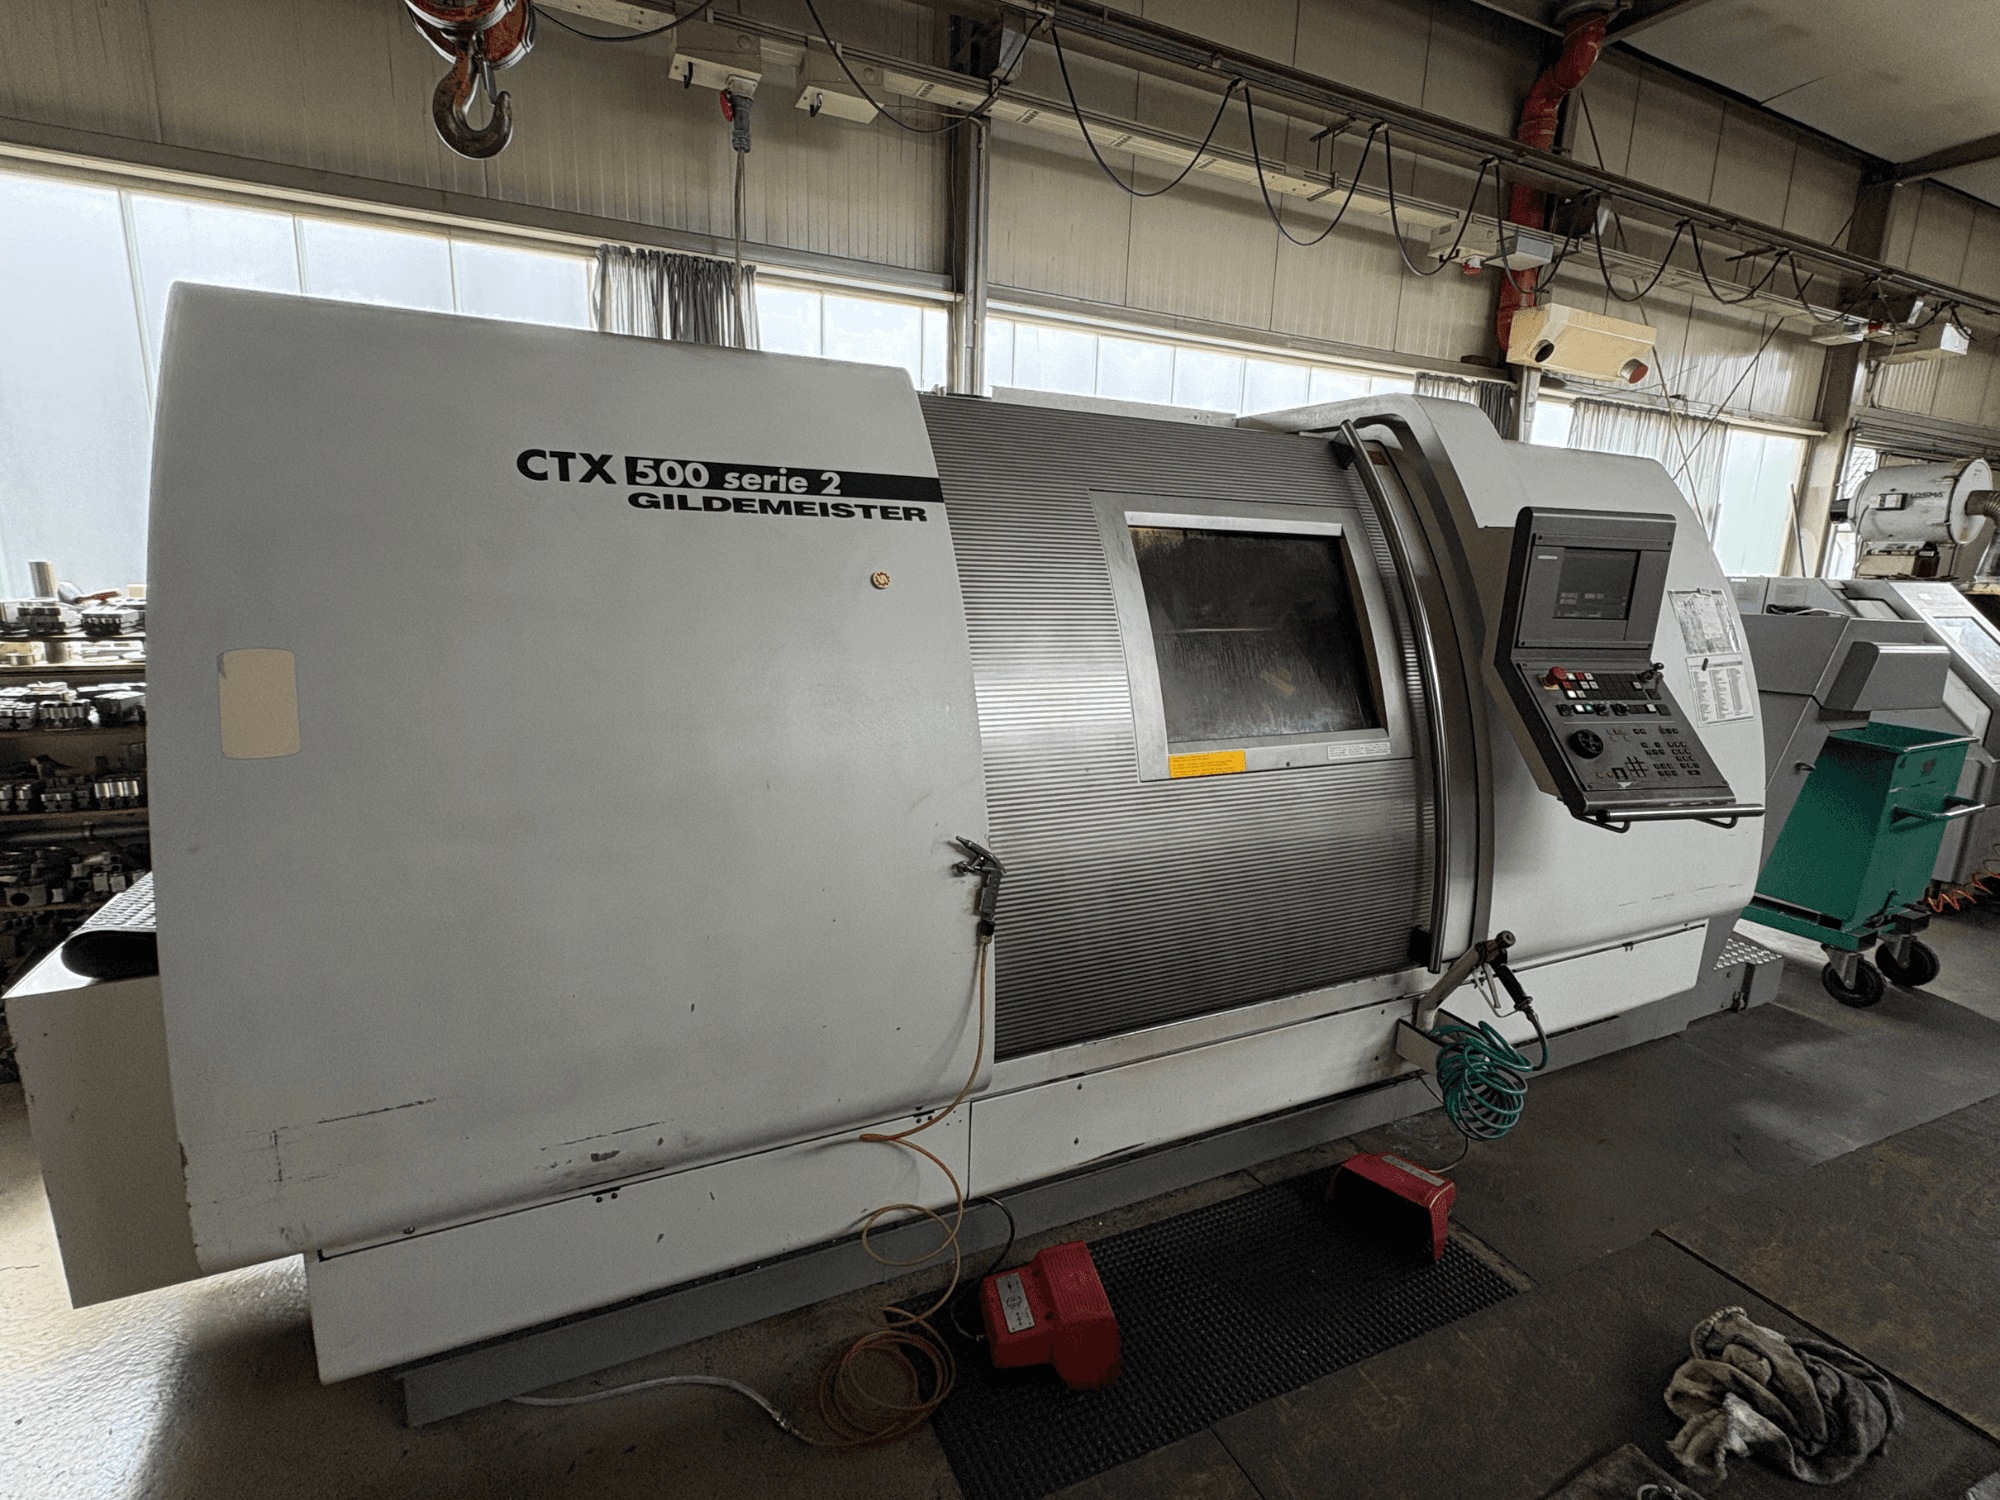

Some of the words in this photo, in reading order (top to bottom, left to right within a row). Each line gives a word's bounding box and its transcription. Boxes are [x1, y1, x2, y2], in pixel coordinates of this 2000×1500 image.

[516, 449, 617, 485] CTX
[635, 459, 710, 488] 500
[723, 468, 809, 493] serie
[820, 471, 841, 495] 2
[627, 492, 928, 522] GILDEMEISTER
